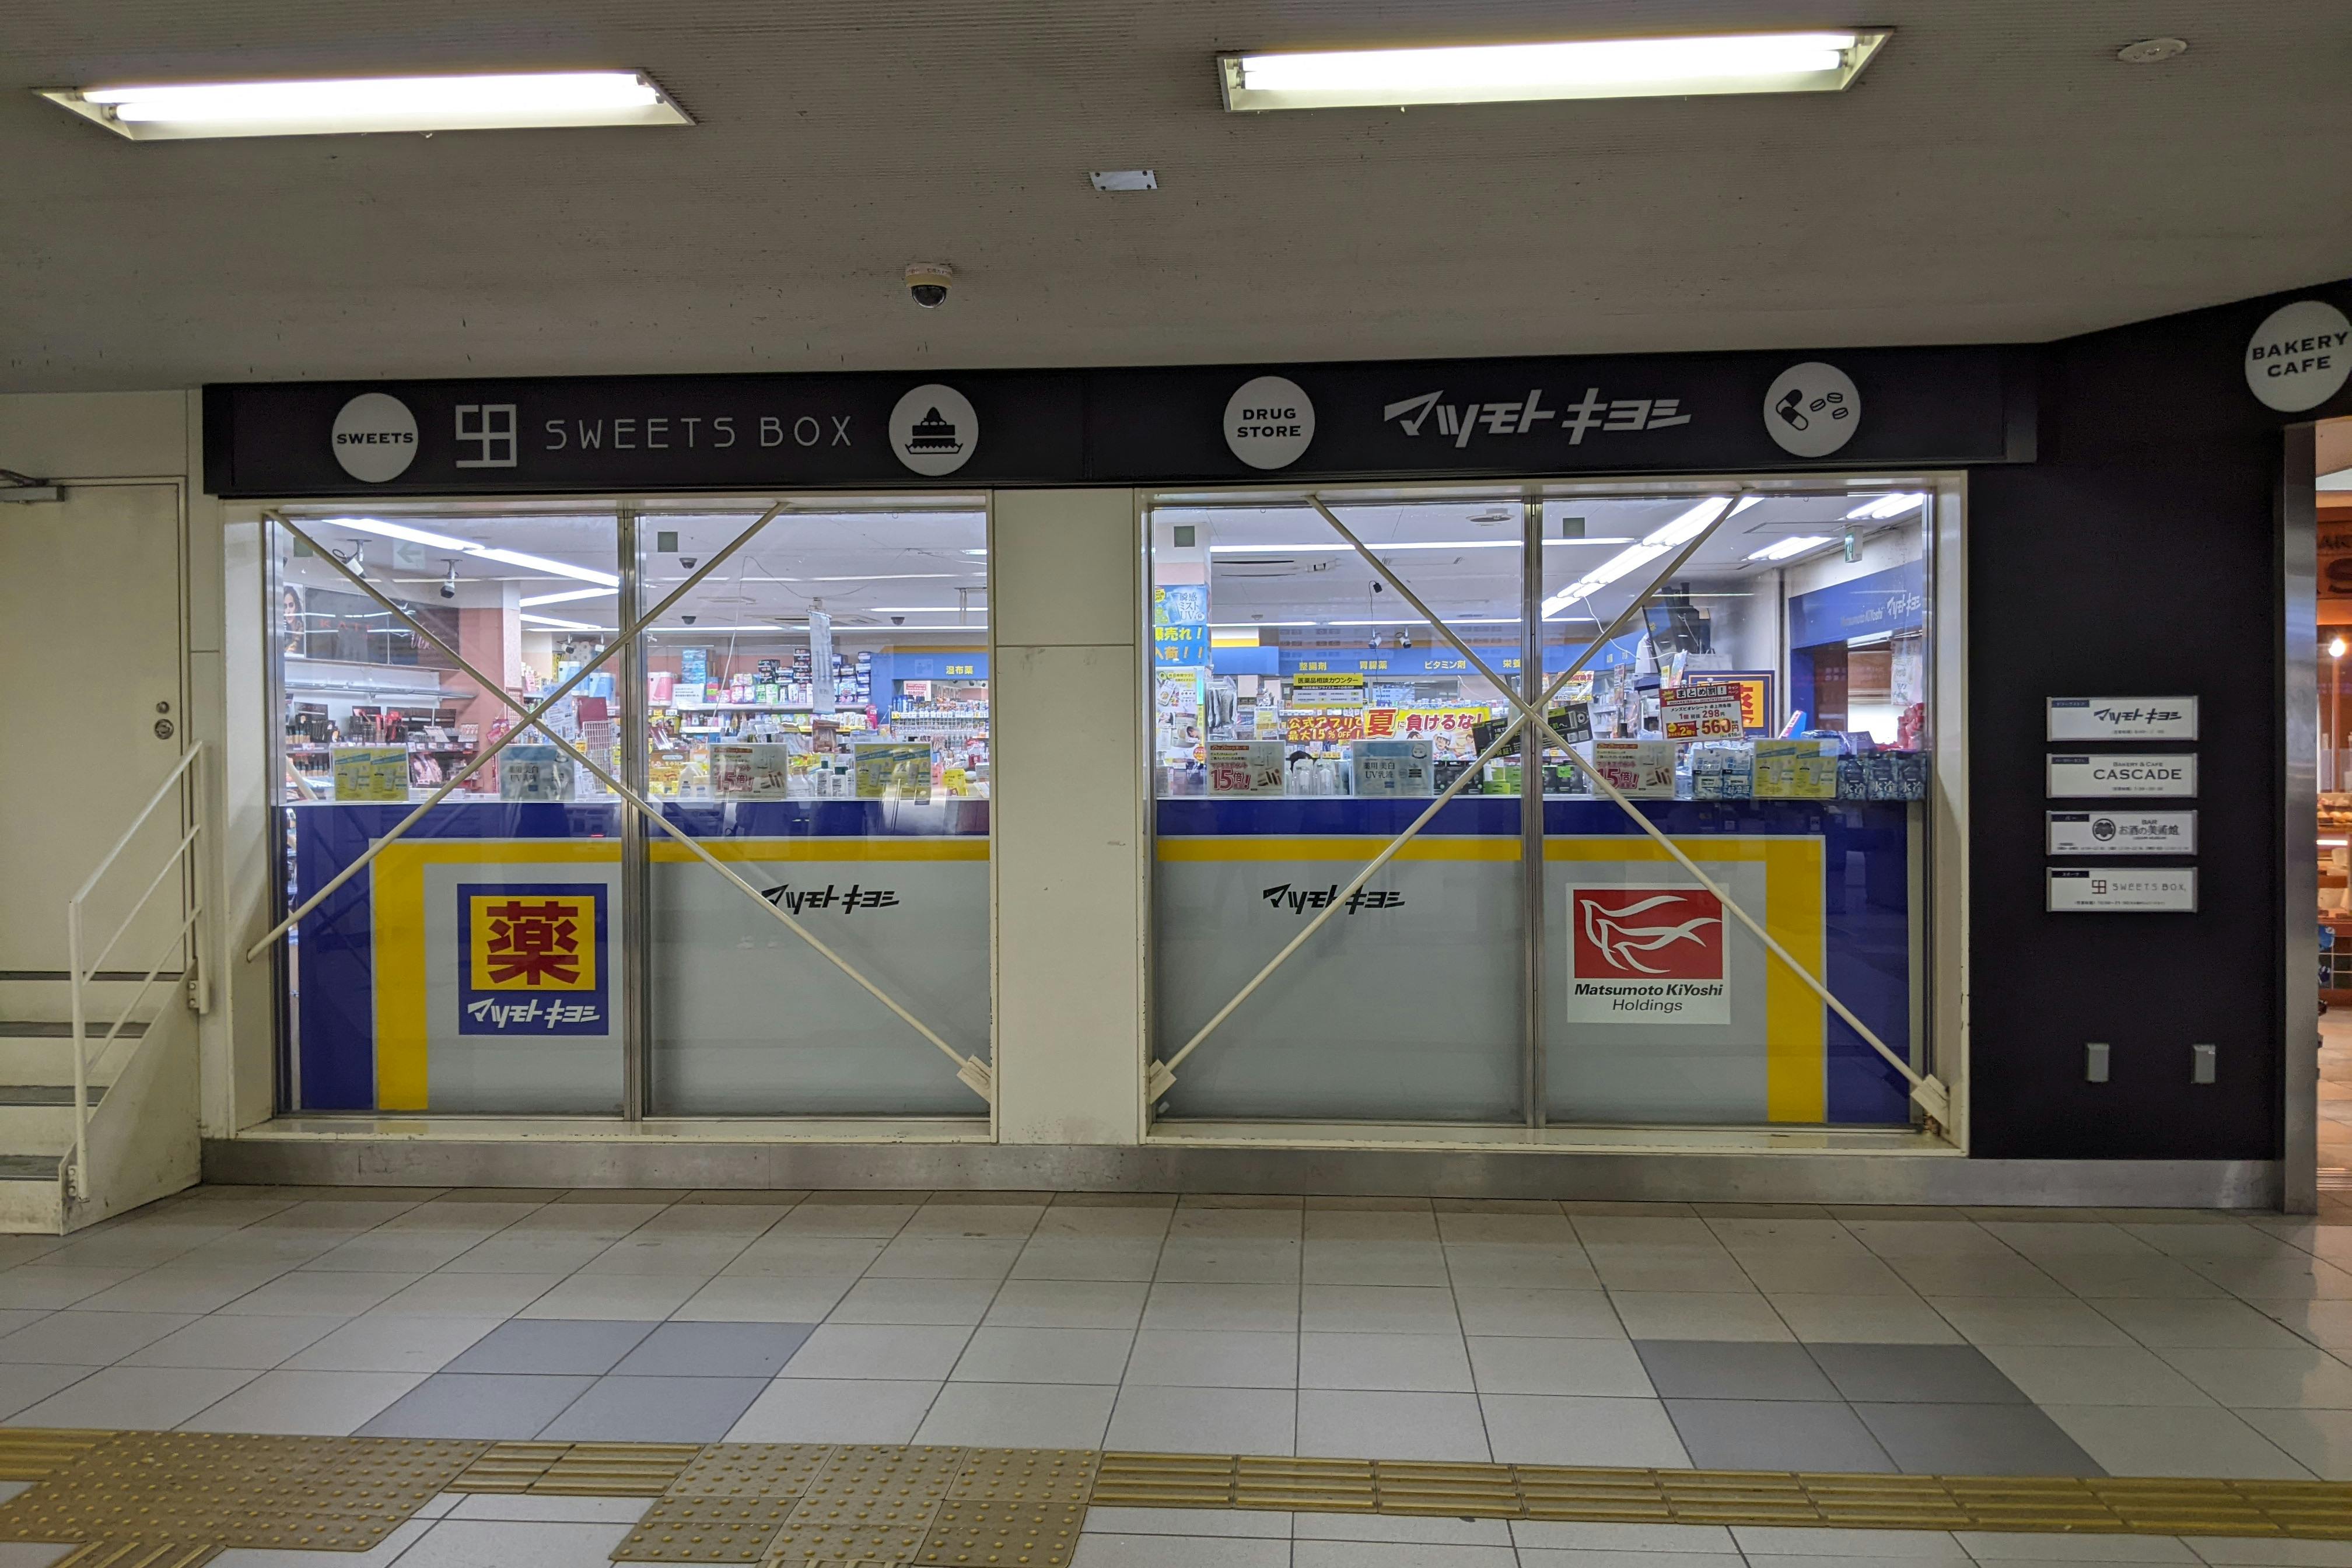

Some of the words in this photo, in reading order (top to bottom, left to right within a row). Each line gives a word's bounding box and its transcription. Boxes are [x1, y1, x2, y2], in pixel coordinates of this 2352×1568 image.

[2252, 331, 2348, 360] BAKERY
[2267, 355, 2331, 377] CAFE
[1243, 408, 1296, 420] DRUG
[337, 432, 414, 444] SWEETS
[545, 416, 736, 450] SWEETS
[760, 415, 852, 447] BOX
[1237, 426, 1301, 438] STORE
[2093, 769, 2182, 780] CASCADE
[2119, 825, 2180, 836] お酒の美術館
[2112, 883, 2158, 891] SWEETS
[487, 901, 581, 985] 薬
[1574, 984, 1664, 996] Matsumoto
[1666, 984, 1724, 996] KiYoshi
[1612, 999, 1683, 1014] Holdings
